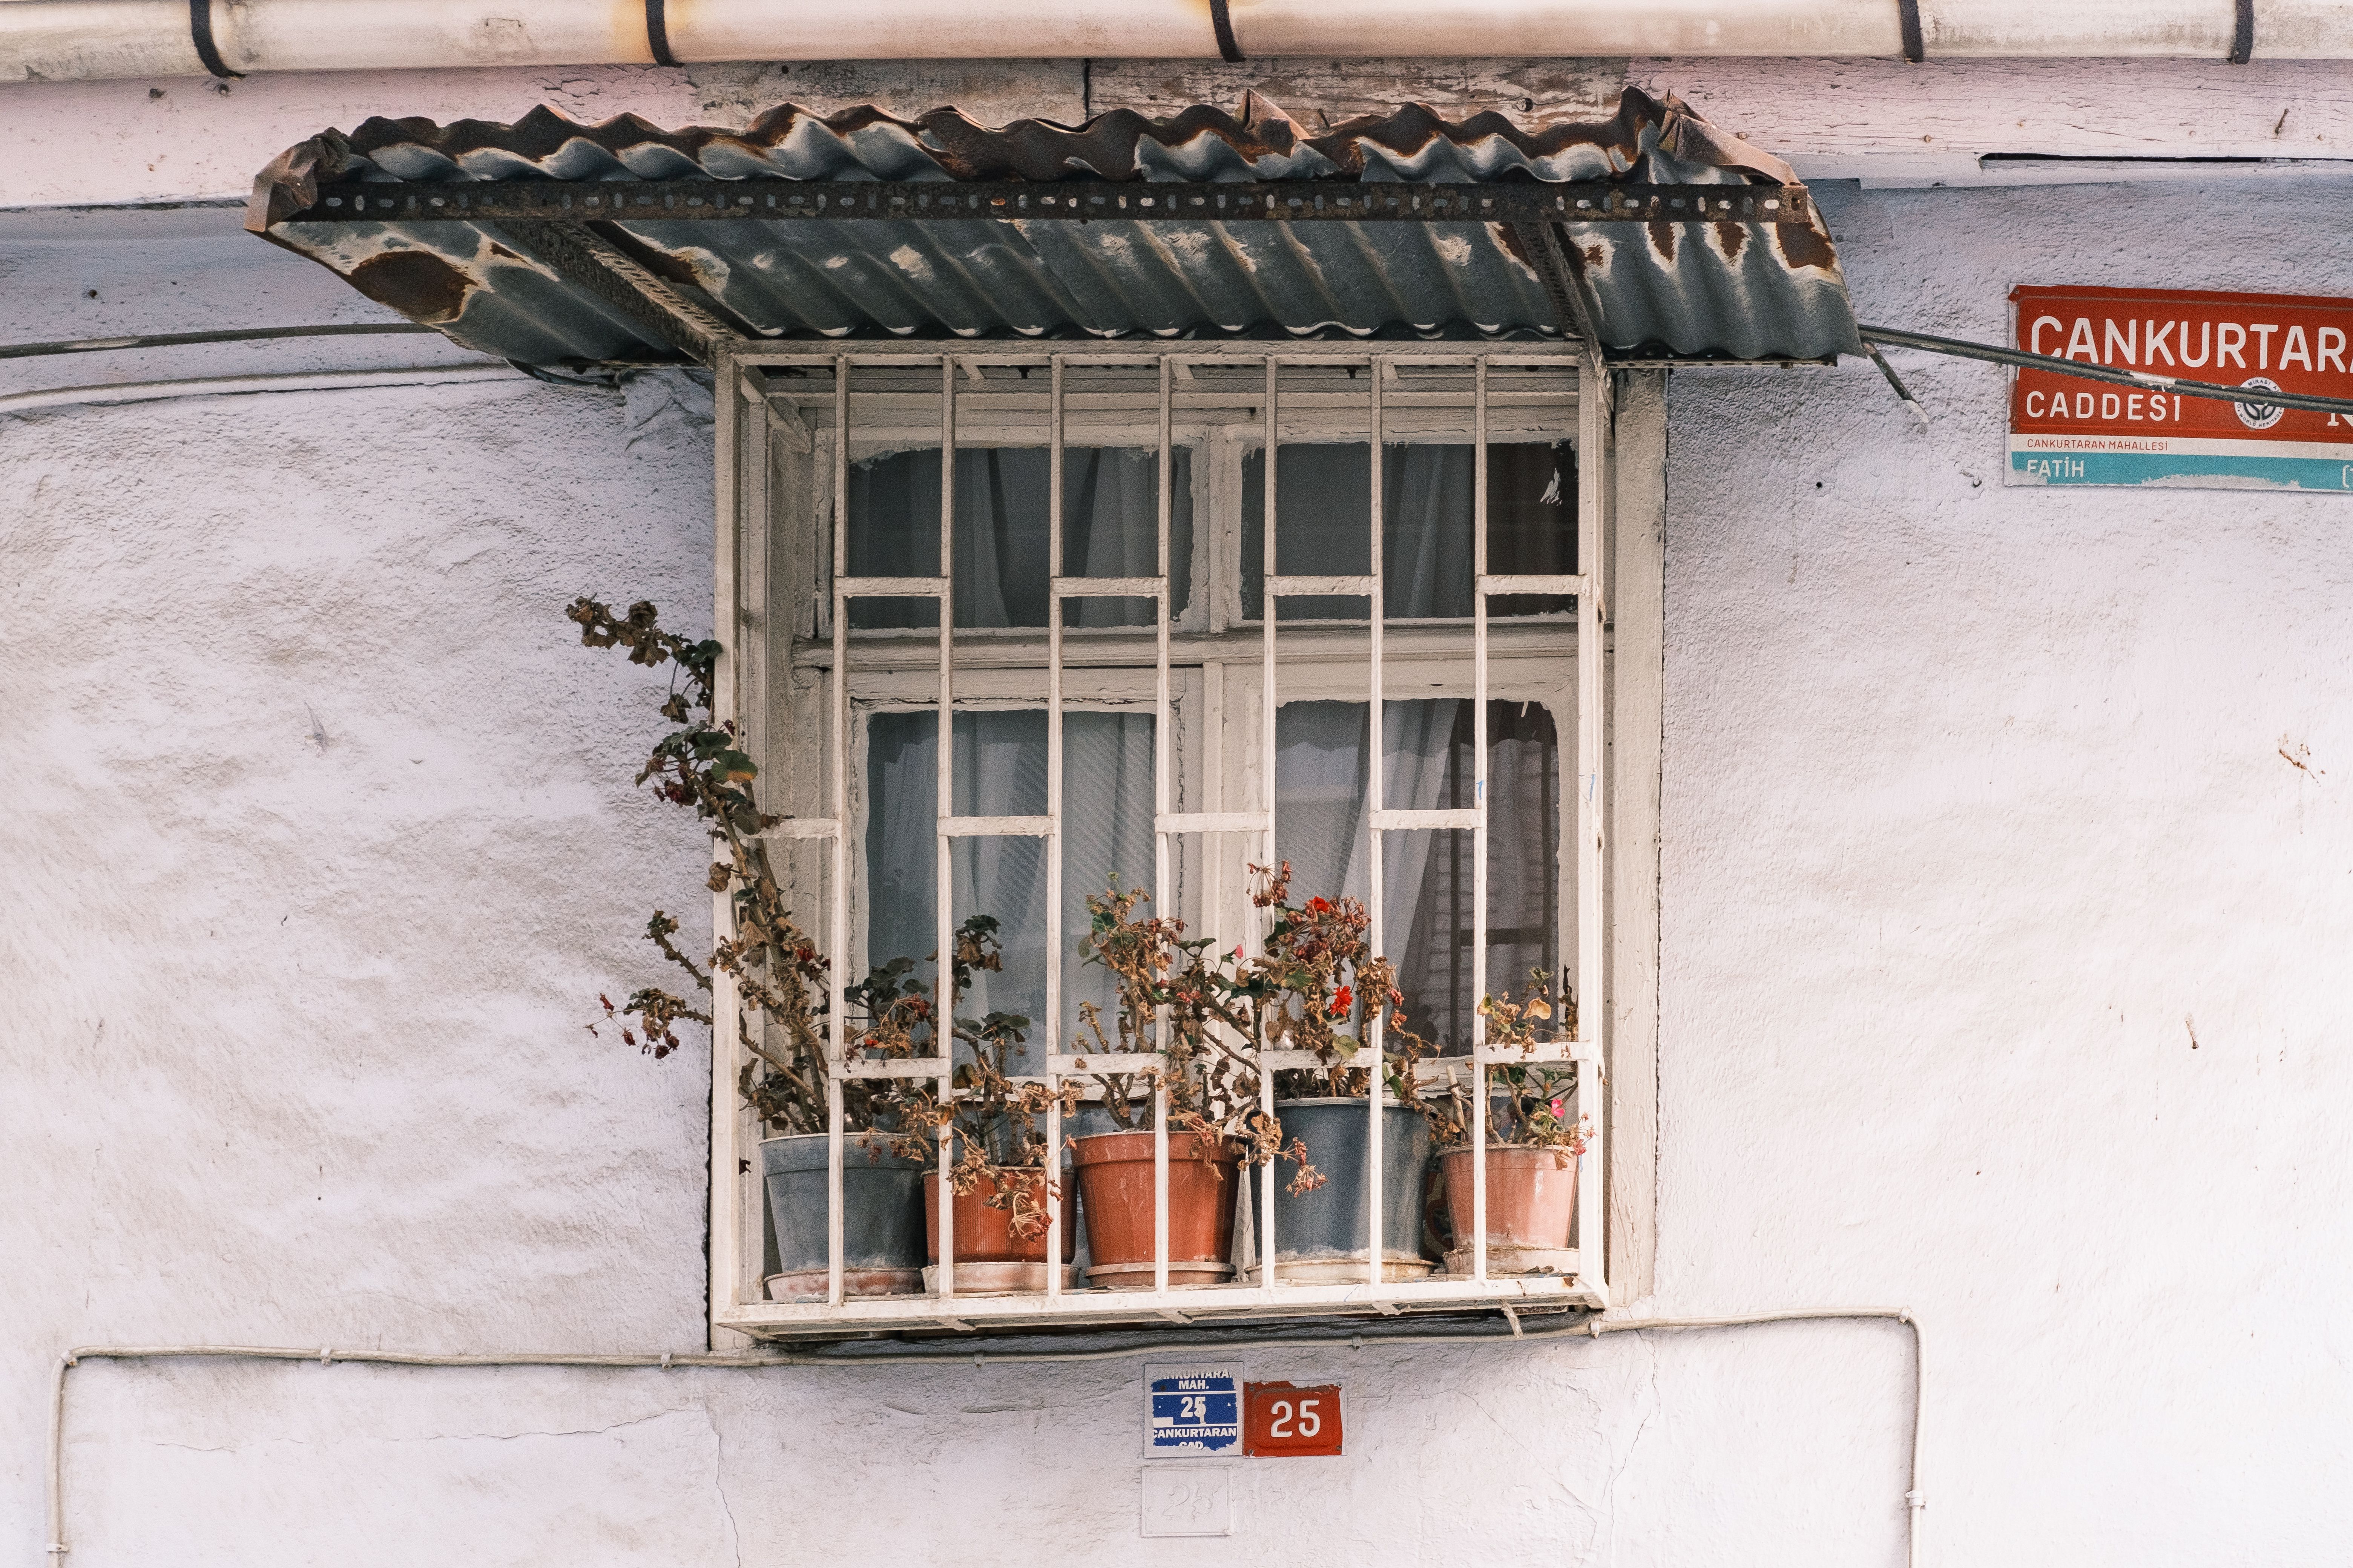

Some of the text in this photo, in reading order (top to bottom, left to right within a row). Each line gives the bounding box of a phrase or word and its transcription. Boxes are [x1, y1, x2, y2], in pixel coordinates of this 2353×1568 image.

[2031, 315, 2353, 373] CANKURTAR
[2239, 411, 2282, 427] WORLD HERITAGE
[2027, 439, 2168, 451] CANKURTARAN MAHALLESİ
[2027, 457, 2084, 477] FATİH
[1179, 1380, 1209, 1390] MAH.
[1181, 1396, 1206, 1418] 25
[1271, 1399, 1320, 1438] 25
[1152, 1427, 1236, 1438] CANKURTARAN
